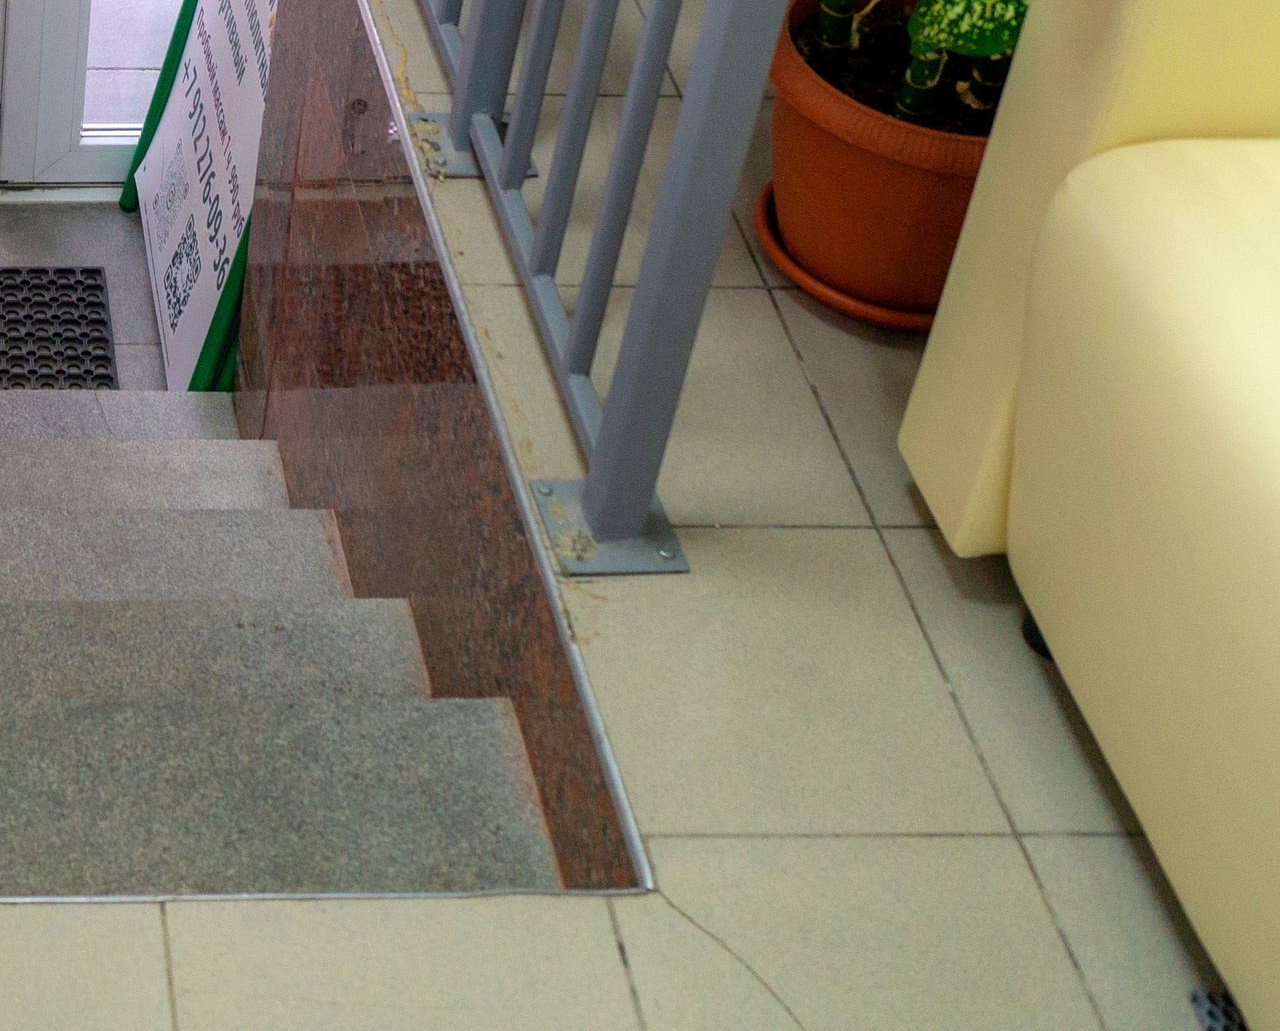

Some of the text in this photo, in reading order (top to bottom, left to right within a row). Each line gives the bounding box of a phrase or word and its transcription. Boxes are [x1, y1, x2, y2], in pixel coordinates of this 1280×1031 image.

[196, 6, 218, 87] Пробный
[212, 79, 227, 146] массаж
[228, 164, 239, 205] 990
[232, 200, 245, 239] руб
